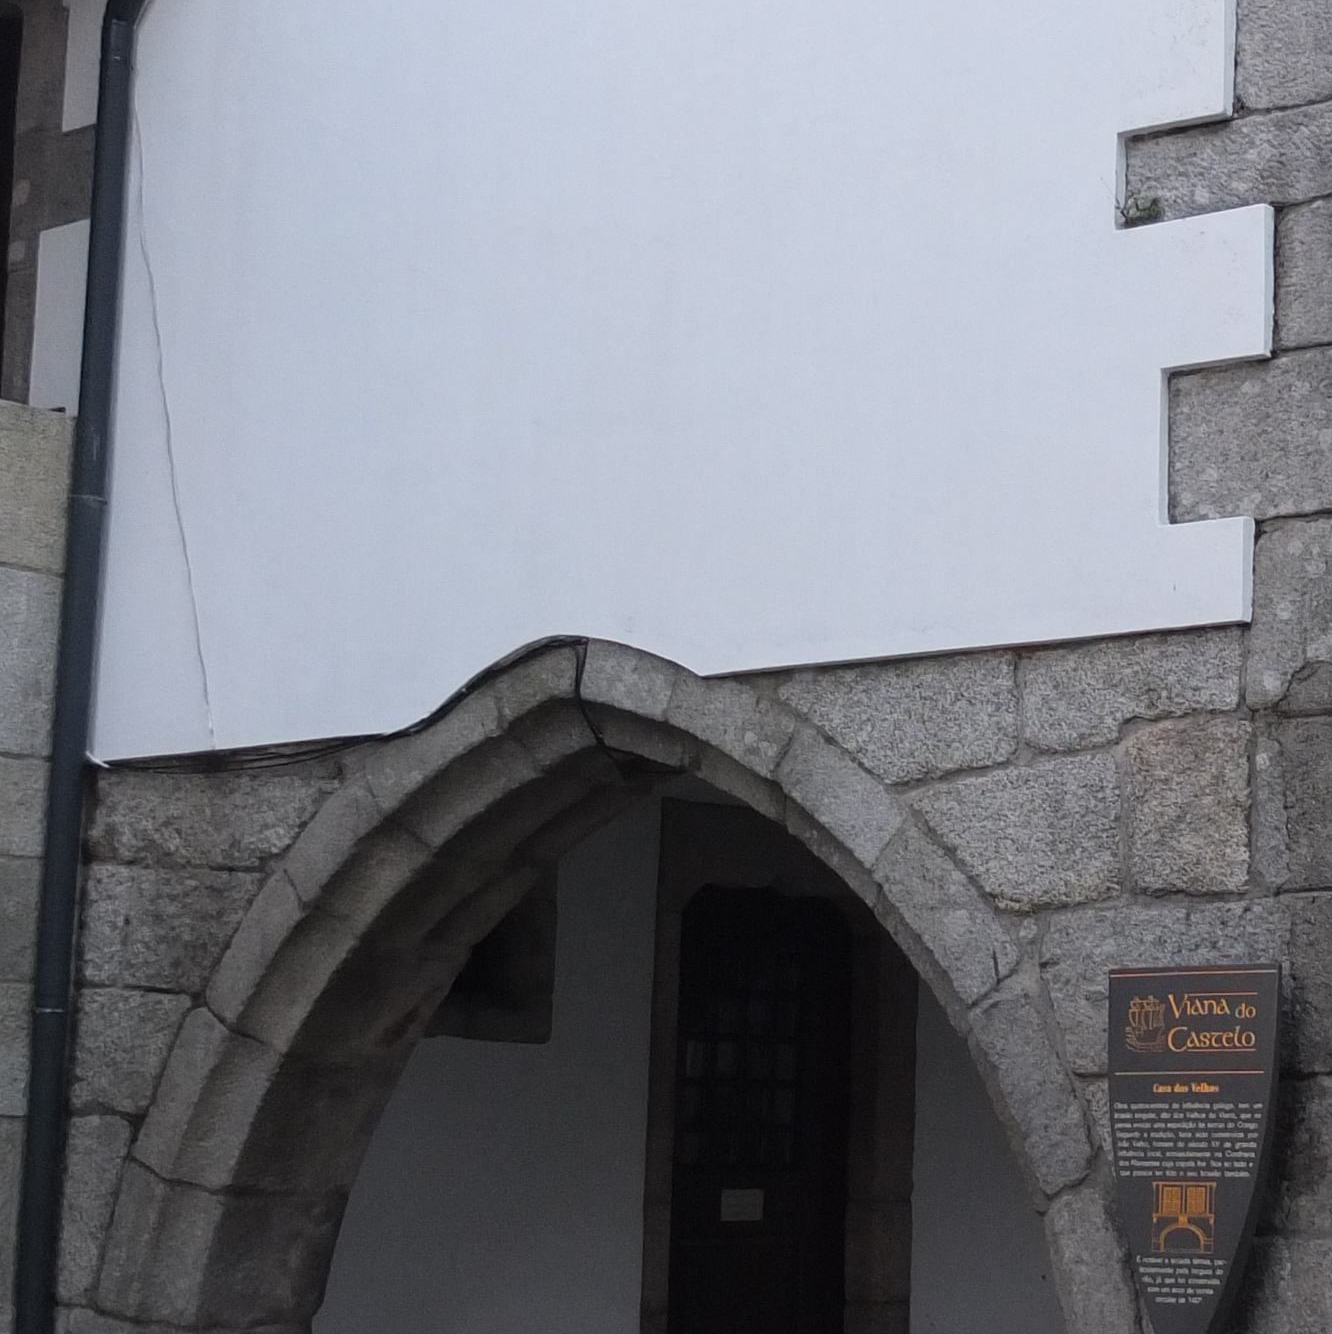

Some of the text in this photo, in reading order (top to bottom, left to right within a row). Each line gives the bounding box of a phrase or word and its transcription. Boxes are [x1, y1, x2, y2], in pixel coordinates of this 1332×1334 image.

[1168, 993, 1256, 1019] Viana do
[1167, 1025, 1256, 1052] Castelo
